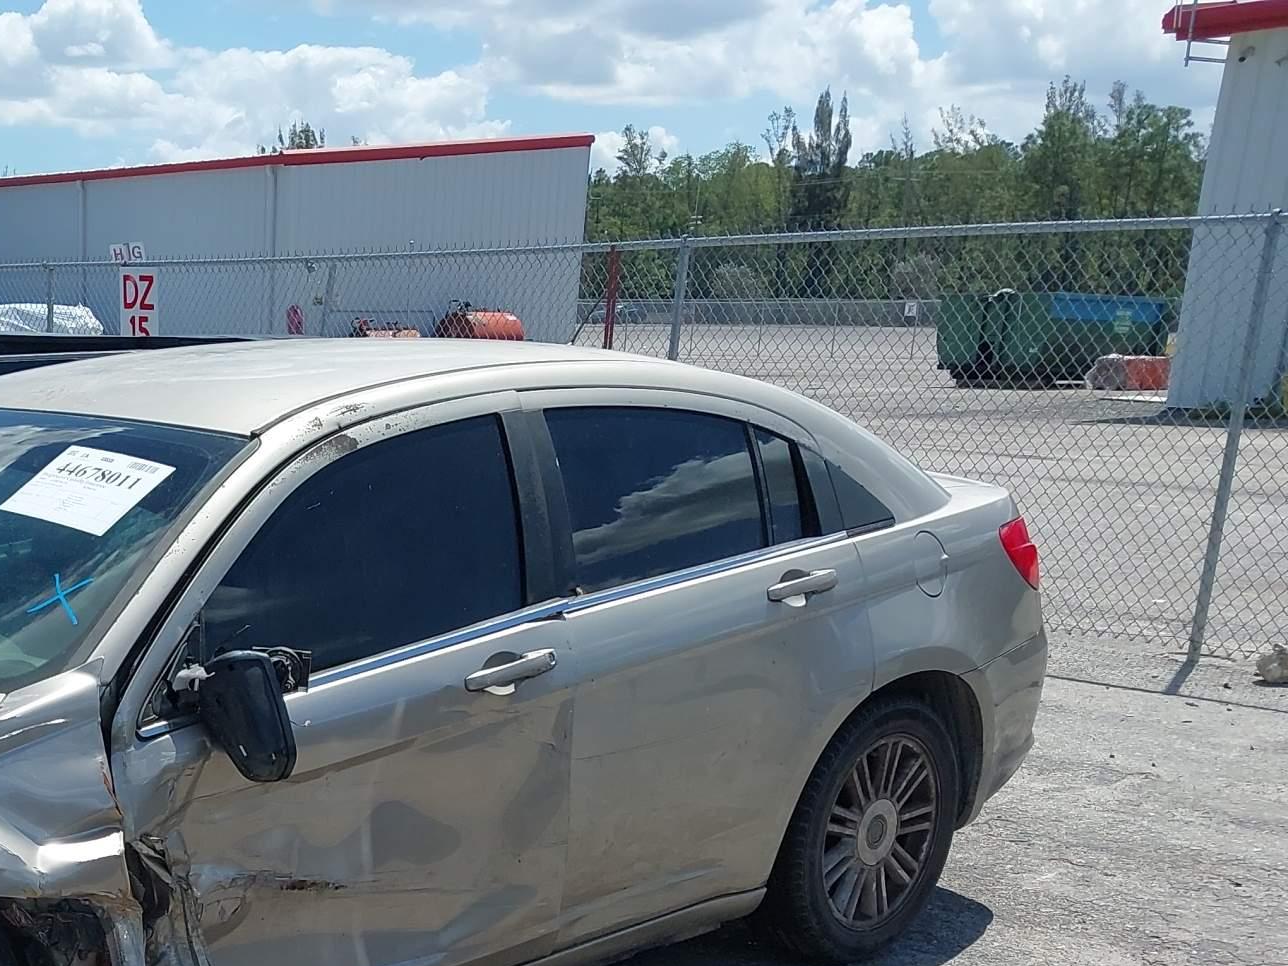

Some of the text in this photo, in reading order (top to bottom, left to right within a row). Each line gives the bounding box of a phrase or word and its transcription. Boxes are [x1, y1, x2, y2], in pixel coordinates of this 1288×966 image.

[123, 274, 154, 311] DZ
[129, 315, 150, 336] 15
[56, 462, 142, 490] 44678011
